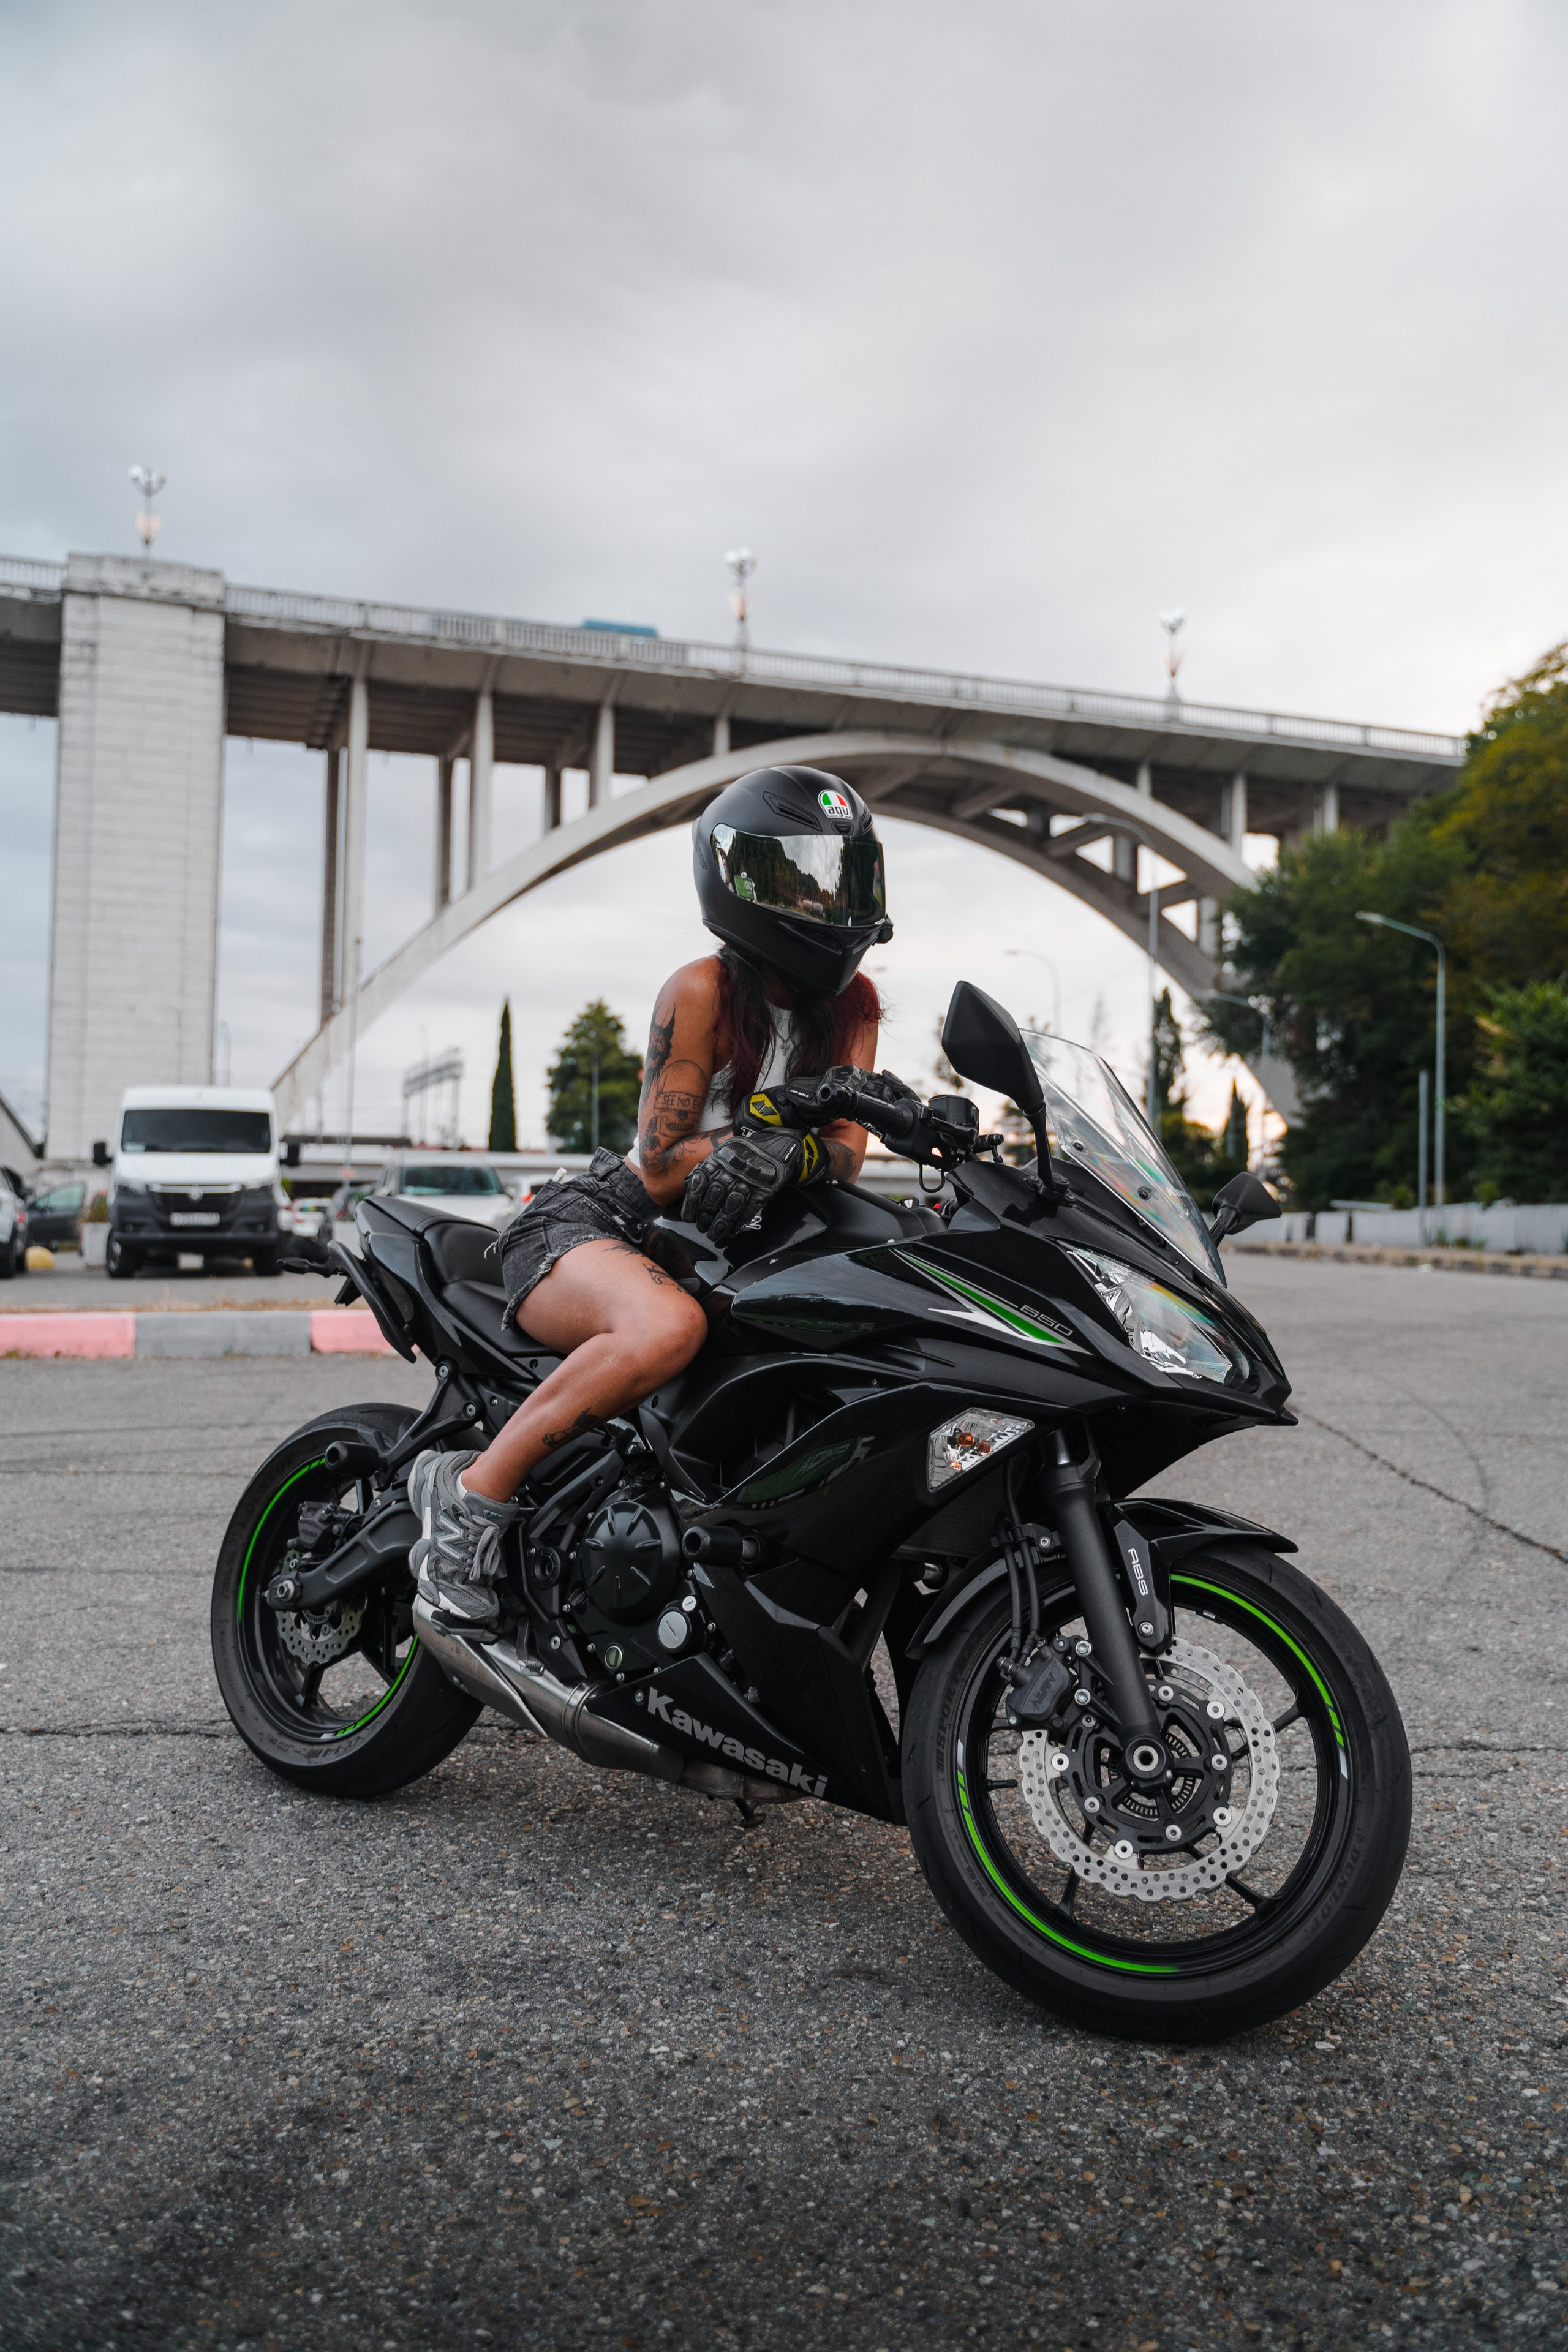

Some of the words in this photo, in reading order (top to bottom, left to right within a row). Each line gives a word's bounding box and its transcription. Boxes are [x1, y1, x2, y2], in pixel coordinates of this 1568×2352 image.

[662, 1094, 676, 1106] SEE
[678, 1097, 690, 1107] NO
[1020, 1305, 1074, 1336] 650
[1128, 1548, 1148, 1596] ABS
[647, 1686, 828, 1798] Kawasaki
[1310, 1844, 1362, 1932] DUNLOP
